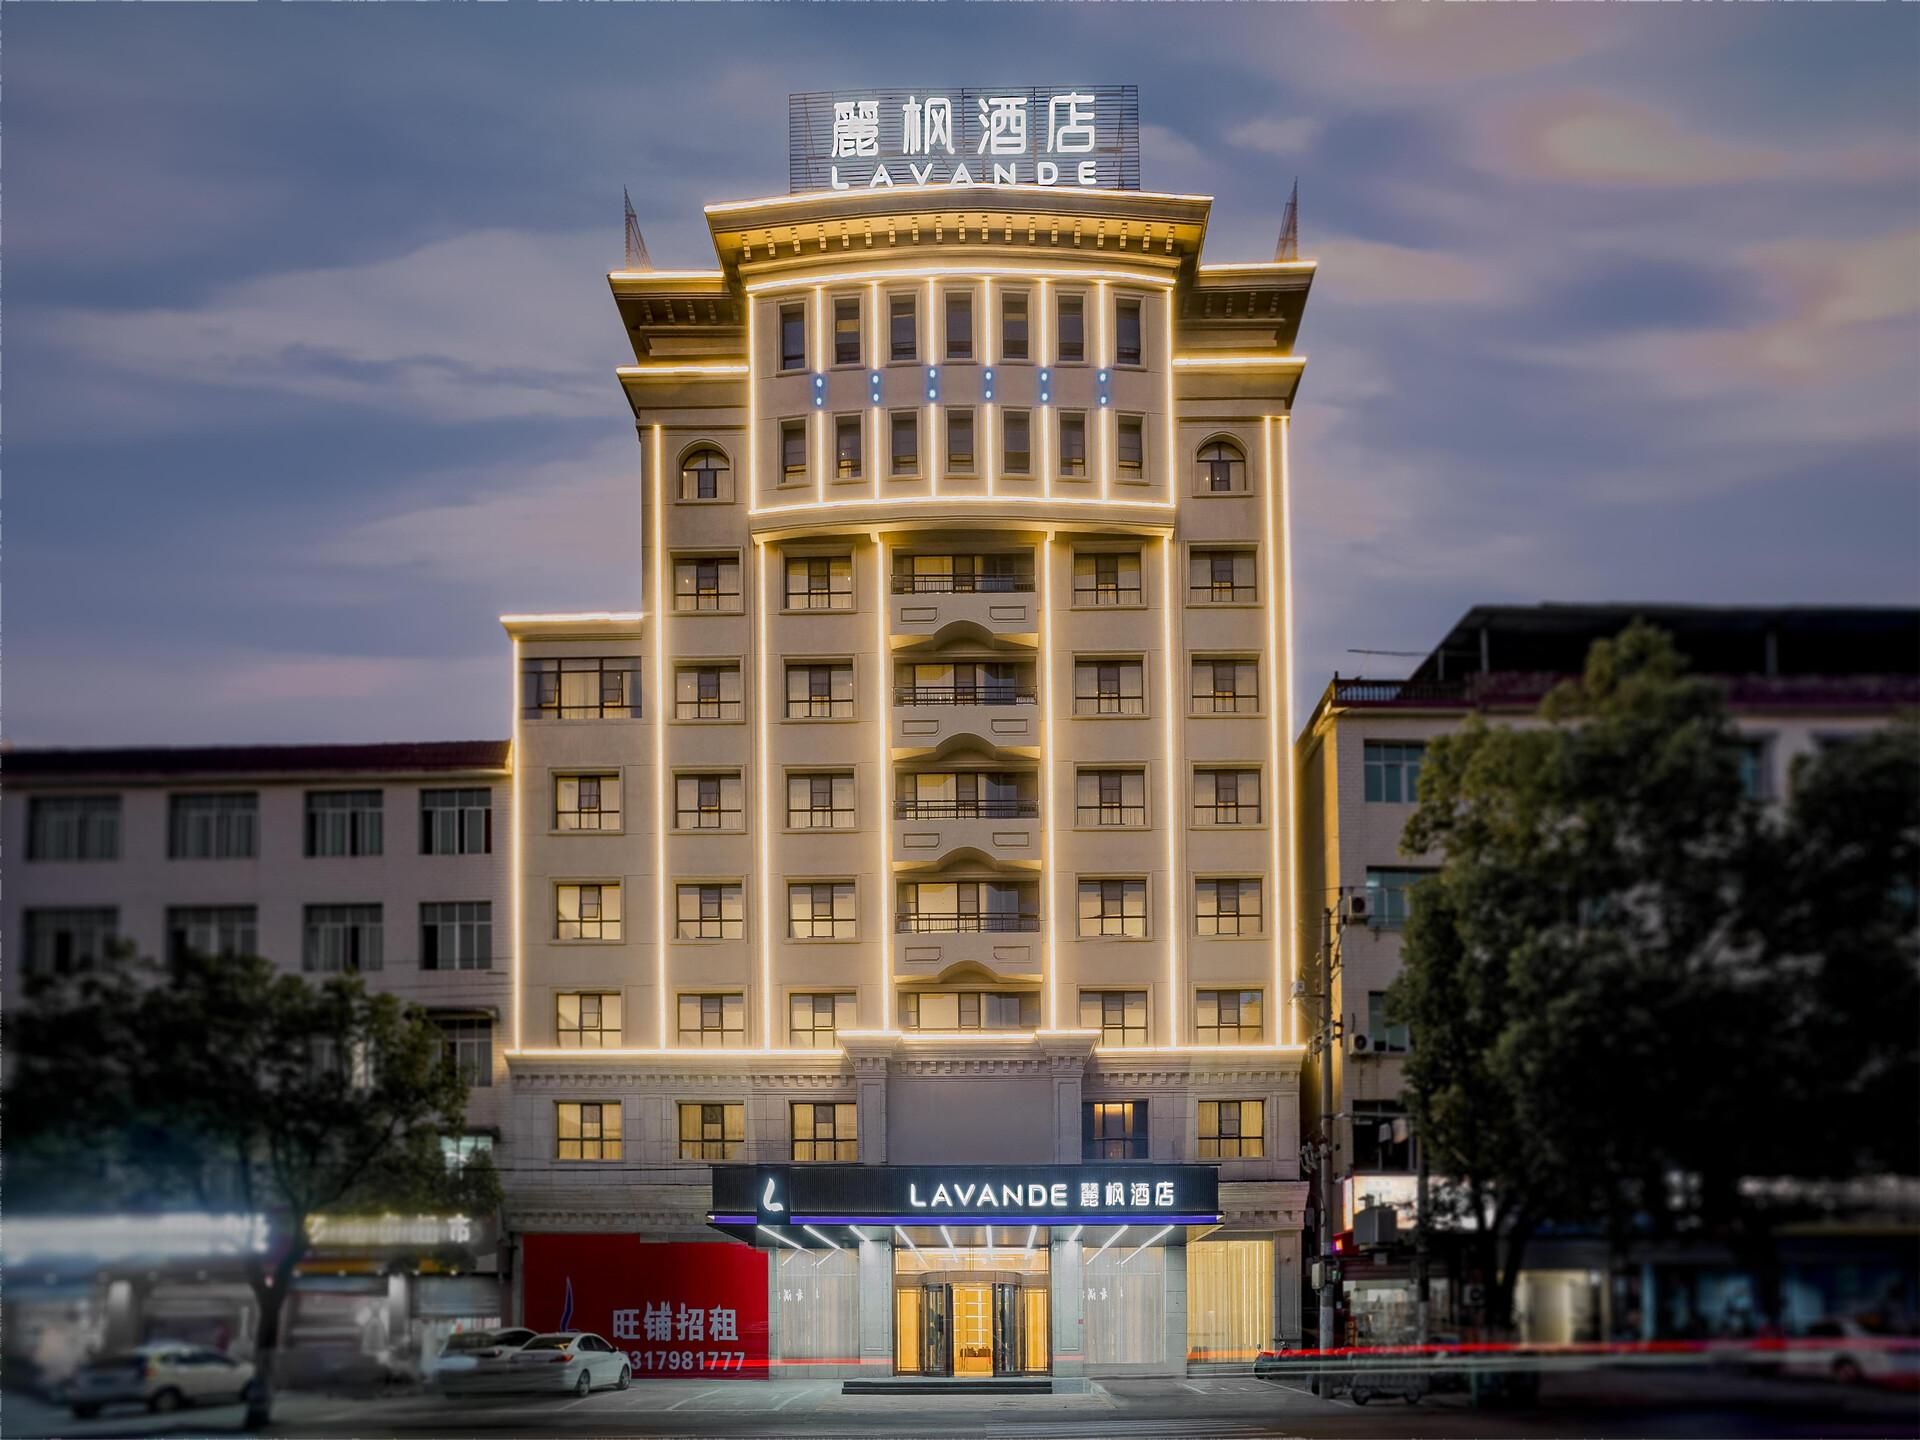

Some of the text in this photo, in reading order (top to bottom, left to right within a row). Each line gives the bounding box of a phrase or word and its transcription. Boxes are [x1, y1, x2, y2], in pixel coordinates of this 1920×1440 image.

[831, 91, 1096, 158] 麗枫酒店
[831, 161, 1097, 190] LAVANDE
[910, 1181, 1174, 1207] LAVANDE 麗枫酒店
[612, 1300, 739, 1342] 旺铺招租
[622, 1350, 745, 1370] 317981777
